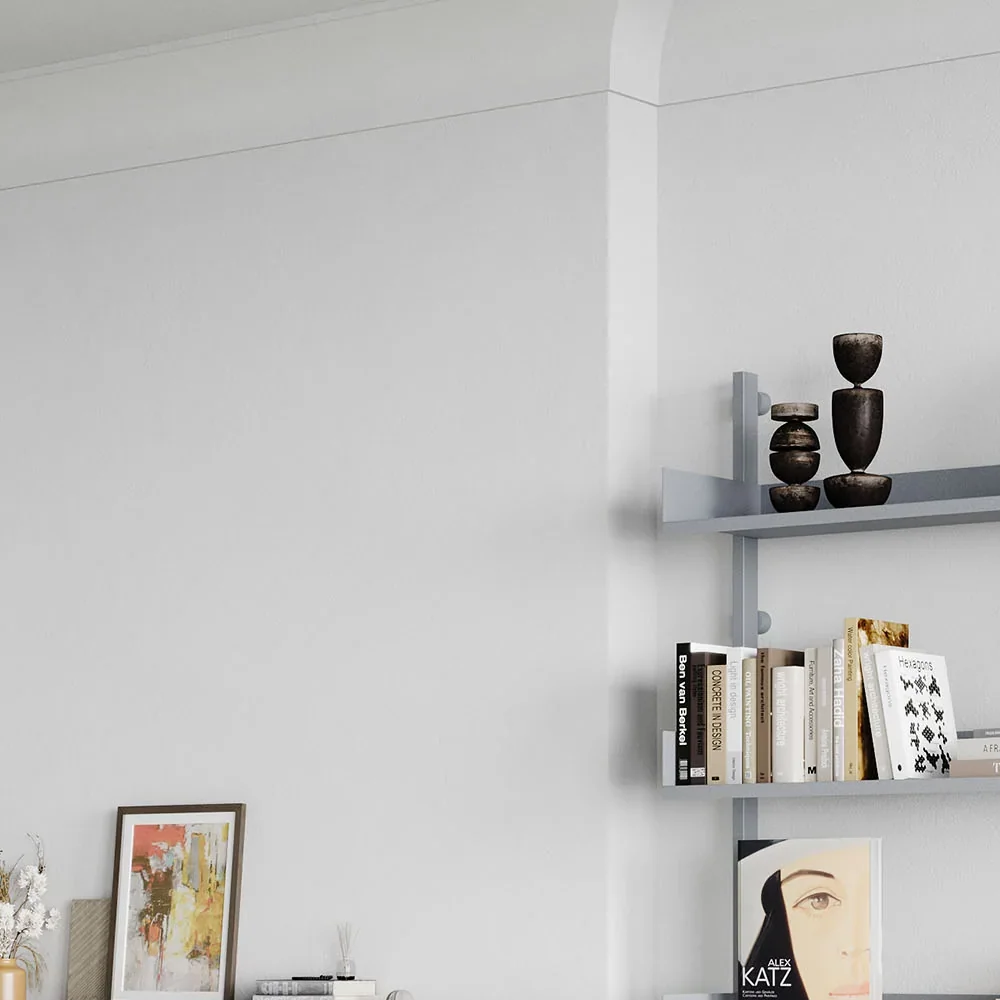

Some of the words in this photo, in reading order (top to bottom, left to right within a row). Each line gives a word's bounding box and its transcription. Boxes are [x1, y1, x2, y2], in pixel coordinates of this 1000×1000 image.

[679, 654, 687, 678] Ben
[728, 661, 738, 681] Light
[834, 648, 844, 683] Zaha
[898, 656, 933, 672] Hexagons
[679, 683, 687, 704] van
[712, 670, 721, 711] CONCRETE
[728, 692, 738, 719] design
[834, 688, 844, 728] Hadid
[679, 708, 687, 746] Berkel
[776, 698, 785, 746] architecture
[712, 722, 721, 751] DESIGN
[983, 744, 988, 752] A
[808, 766, 816, 774] M
[768, 958, 791, 966] ALEX
[742, 967, 792, 986] KATZ
